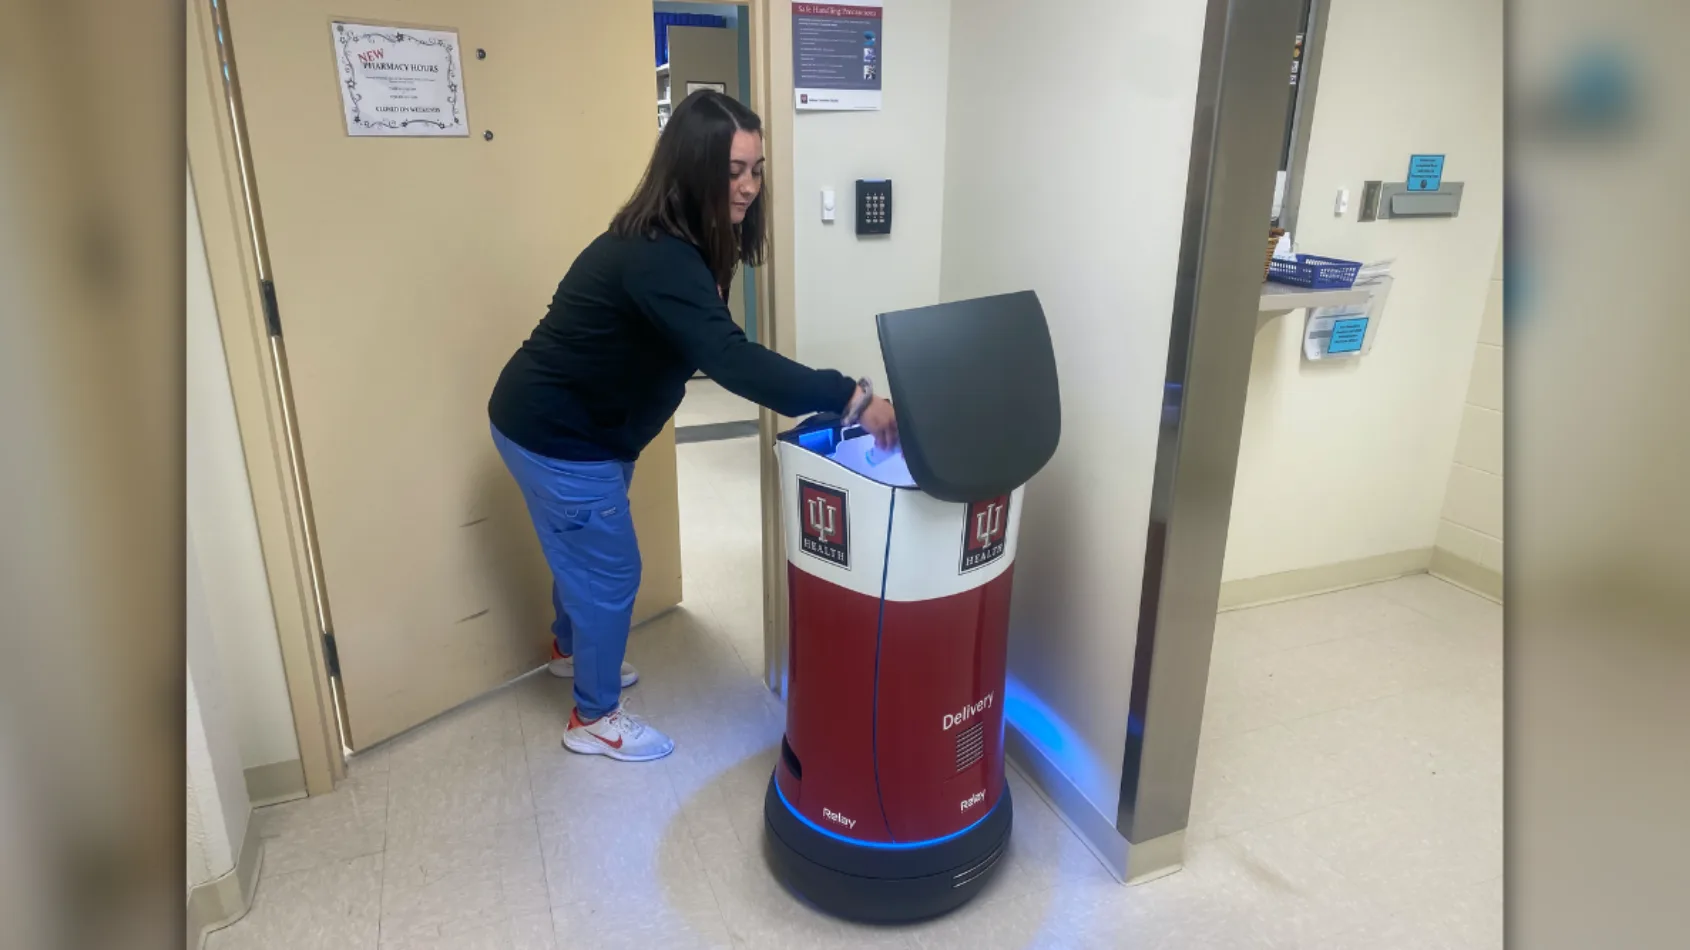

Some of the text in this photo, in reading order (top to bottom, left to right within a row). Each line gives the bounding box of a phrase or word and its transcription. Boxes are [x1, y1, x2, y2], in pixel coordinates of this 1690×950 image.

[812, 6, 841, 16] Handling
[357, 48, 384, 64] NEW
[363, 62, 439, 73] PHARMACY HOURS
[803, 538, 845, 562] HEALTH
[966, 542, 1004, 567] HEALTH
[943, 690, 995, 731] Delivery
[960, 789, 987, 814] Relay
[822, 807, 857, 830] Relay
